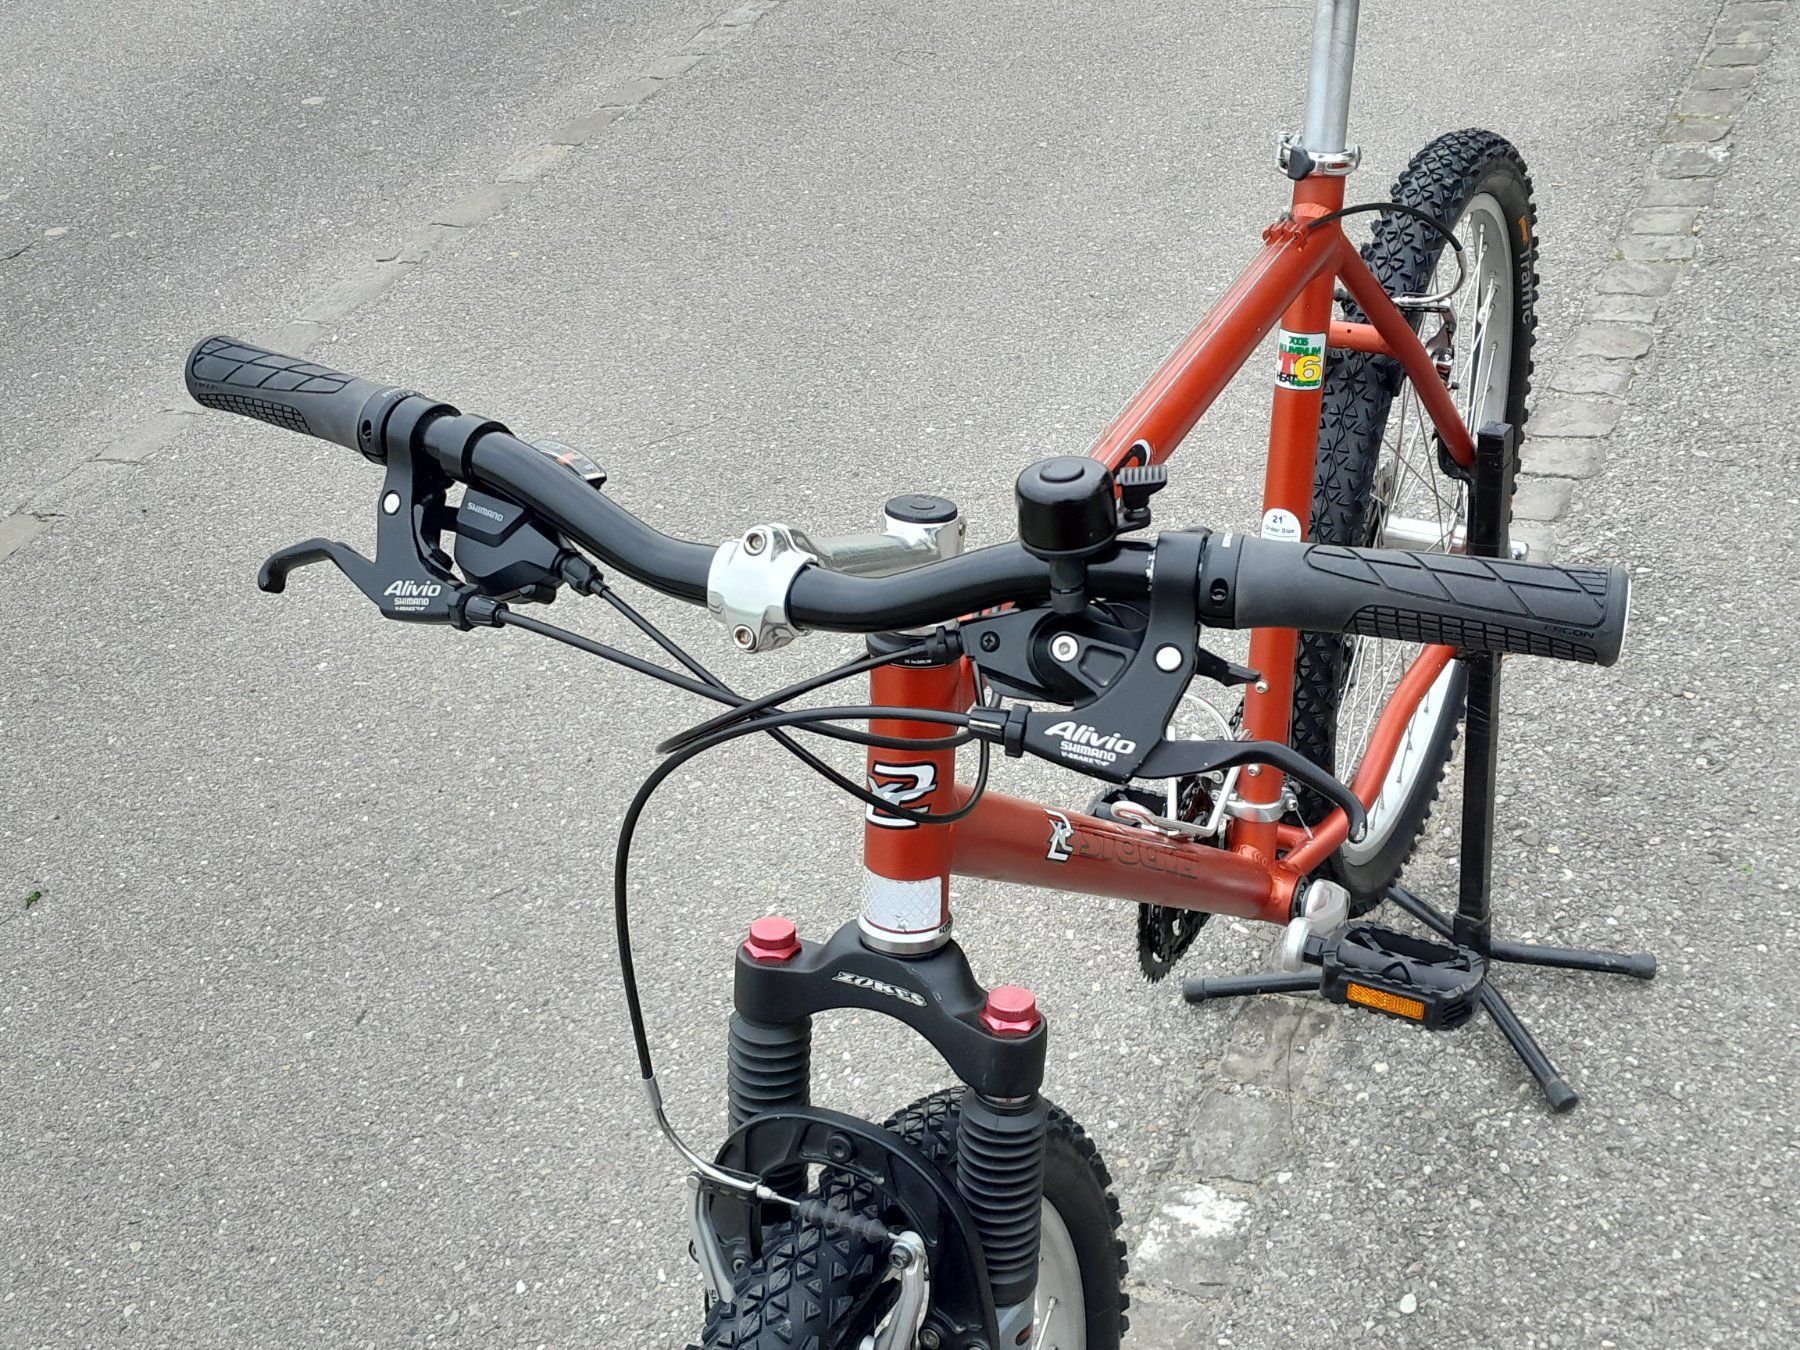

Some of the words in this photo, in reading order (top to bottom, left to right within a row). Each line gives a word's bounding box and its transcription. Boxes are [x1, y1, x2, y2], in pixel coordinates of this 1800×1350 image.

[1519, 250, 1532, 325] Traffic
[1278, 352, 1322, 382] T6
[467, 502, 503, 522] SHIMANO
[384, 580, 442, 597] Alivio
[394, 597, 430, 606] SHIMANO
[1044, 721, 1137, 754] Alivio
[1060, 740, 1116, 762] SHIMANO
[831, 971, 928, 1007] ZOKES
